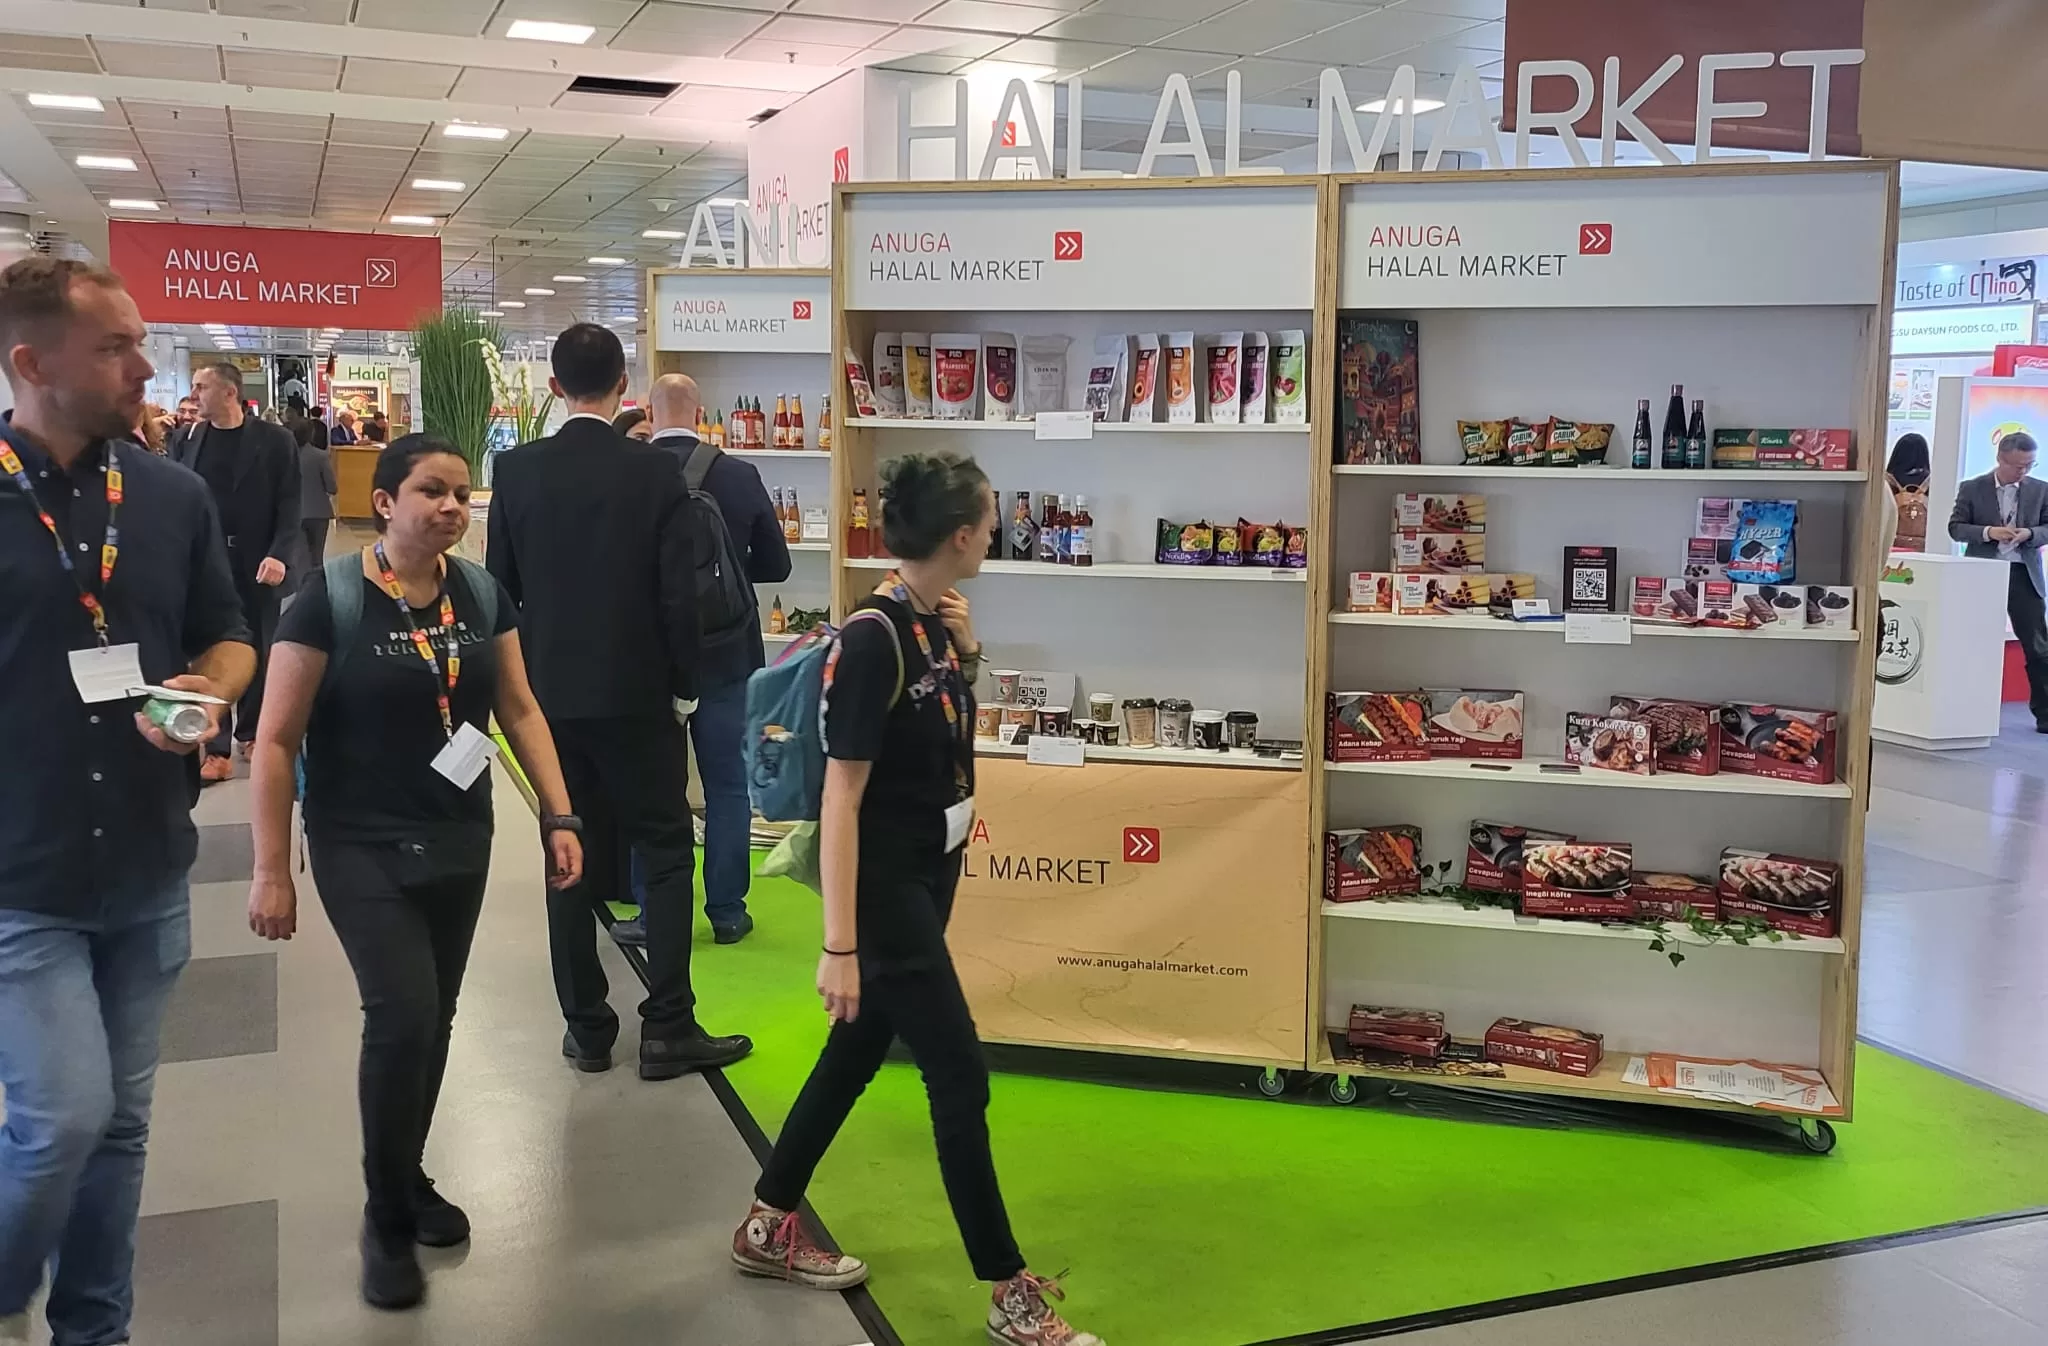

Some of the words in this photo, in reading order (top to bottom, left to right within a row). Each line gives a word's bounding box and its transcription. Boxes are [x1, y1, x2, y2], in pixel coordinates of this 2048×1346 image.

[899, 70, 1284, 180] HALAL
[1319, 47, 1866, 172] MARKET
[787, 203, 829, 242] ARKET
[870, 232, 951, 253] ANUGA
[1369, 225, 1461, 249] ANUGA
[164, 248, 260, 274] ANUGA
[869, 259, 941, 281] HALAL
[950, 259, 1044, 281] MARKET
[1368, 255, 1449, 277] HALAL
[1459, 254, 1567, 277] MARKET
[164, 276, 249, 302] HALAL
[258, 280, 362, 306] MARKET
[1900, 280, 1943, 302] Taste
[1948, 275, 1965, 298] of
[673, 300, 727, 314] ANUGA
[673, 318, 721, 333] HALAL
[726, 318, 788, 333] MARKET
[1911, 326, 1946, 336] DAYSUN
[1949, 324, 1979, 334] FOODS
[1740, 527, 1782, 540] HYPER
[1569, 715, 1591, 726] Kuzu
[990, 854, 1111, 885] MARKET
[1328, 835, 1336, 897] LALESOY
[1341, 879, 1361, 887] Adana
[1550, 891, 1572, 899] Köfte
[1056, 954, 1249, 977] www.anugahalalmarket.com
